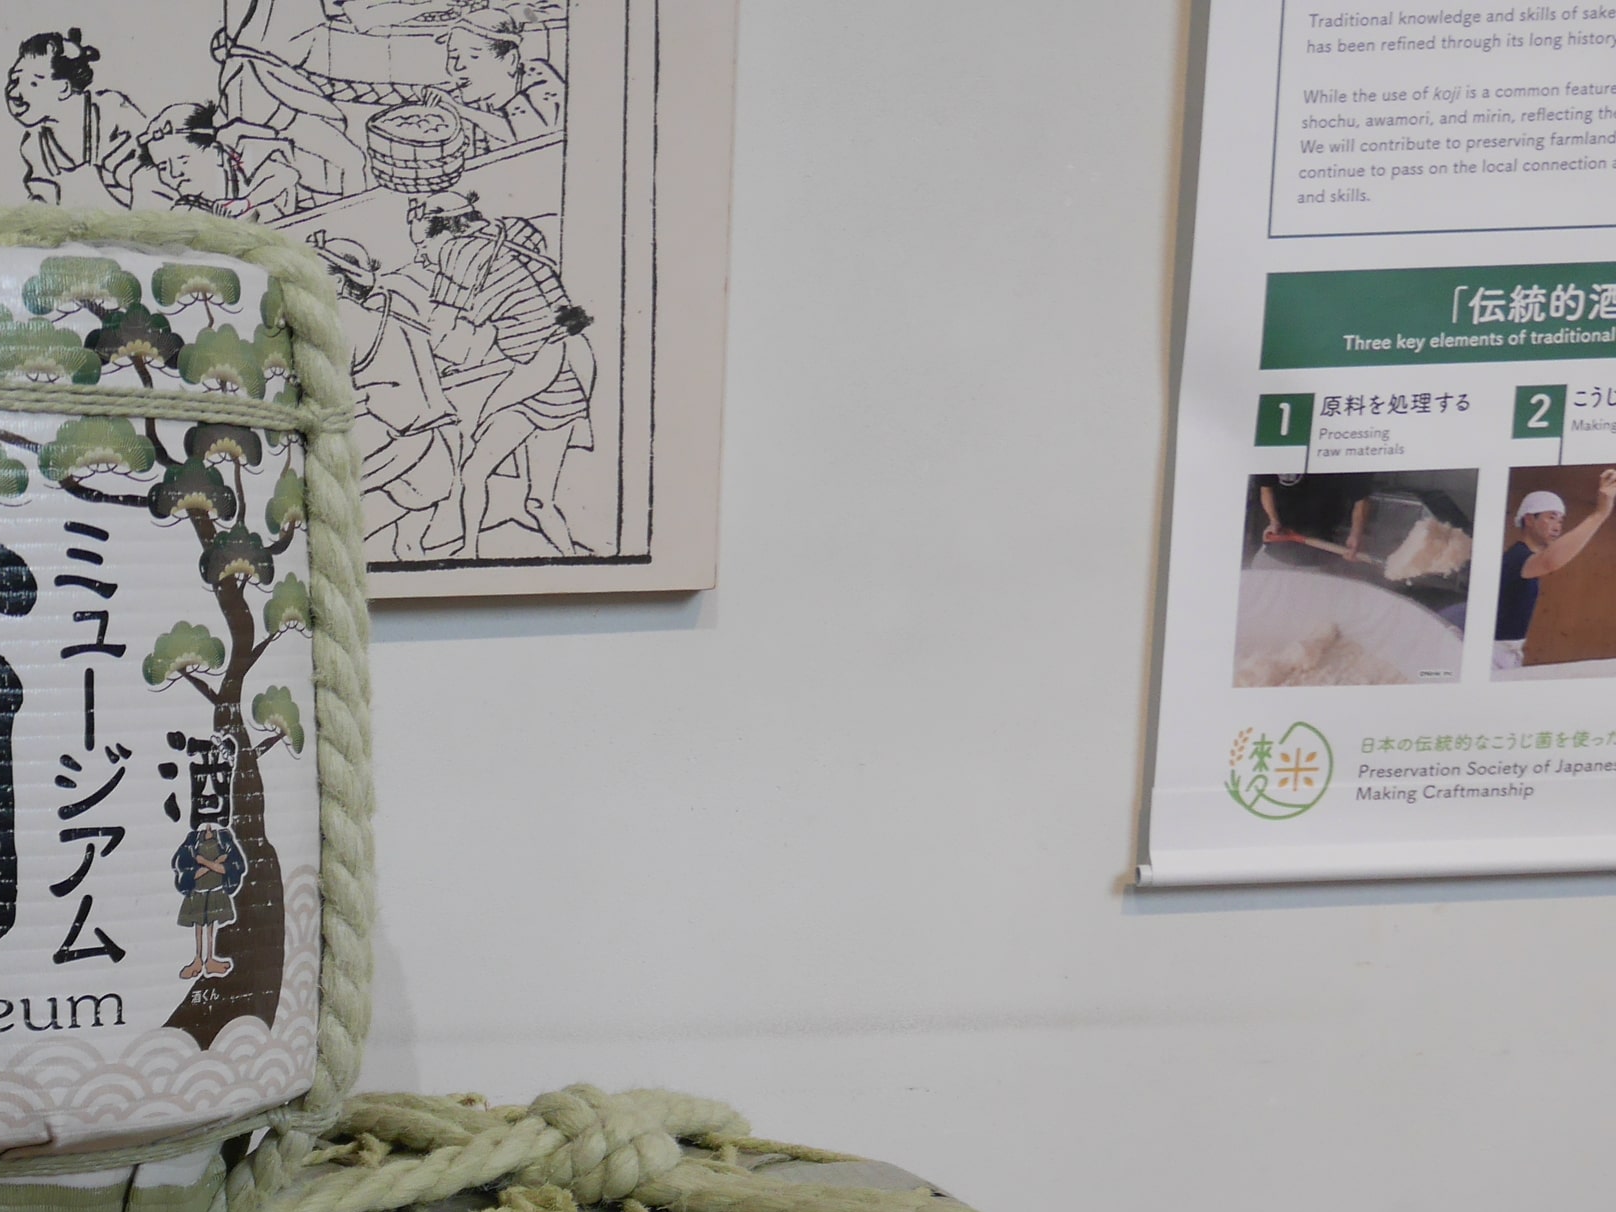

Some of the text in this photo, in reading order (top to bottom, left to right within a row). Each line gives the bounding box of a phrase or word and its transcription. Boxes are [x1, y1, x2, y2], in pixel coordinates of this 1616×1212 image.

[1308, 5, 1616, 28] Traditional knowledge and skills of sake
[1306, 31, 1616, 54] has been refined through its long history
[1303, 89, 1347, 104] While
[1352, 88, 1377, 103] the
[1382, 89, 1407, 102] use
[1412, 86, 1430, 101] of
[1433, 86, 1461, 104] koji
[1465, 84, 1477, 99] is
[1481, 88, 1490, 99] a
[1495, 86, 1560, 99] common
[1301, 114, 1360, 129] shochu,
[1365, 111, 1434, 127] awamori,
[1439, 110, 1467, 125] and
[1472, 108, 1516, 124] mirin,
[1520, 106, 1593, 124] reflecting
[1300, 139, 1324, 154] We
[1329, 138, 1355, 153] will
[1359, 136, 1441, 152] contribute
[1446, 137, 1461, 150] to
[1466, 133, 1545, 152] preserving
[1298, 164, 1365, 179] continue
[1370, 165, 1386, 177] to
[1390, 164, 1424, 180] pass
[1428, 164, 1448, 175] on
[1453, 160, 1477, 174] the
[1482, 158, 1518, 173] local
[1522, 155, 1607, 172] connection
[1297, 187, 1371, 204] and skills.
[1343, 326, 1616, 353] Three key elements of traditional
[1319, 392, 1471, 418] 原料を処理する
[1527, 393, 1552, 429] 2
[1278, 402, 1290, 437] 1
[1319, 427, 1391, 442] Processing
[1317, 443, 1405, 458] raw materials
[49, 521, 131, 966] ミュージアム
[1358, 761, 1461, 779] Preservation
[1466, 760, 1527, 779] Society
[1533, 759, 1551, 774] of
[1355, 782, 1534, 804] Making Craftmanship
